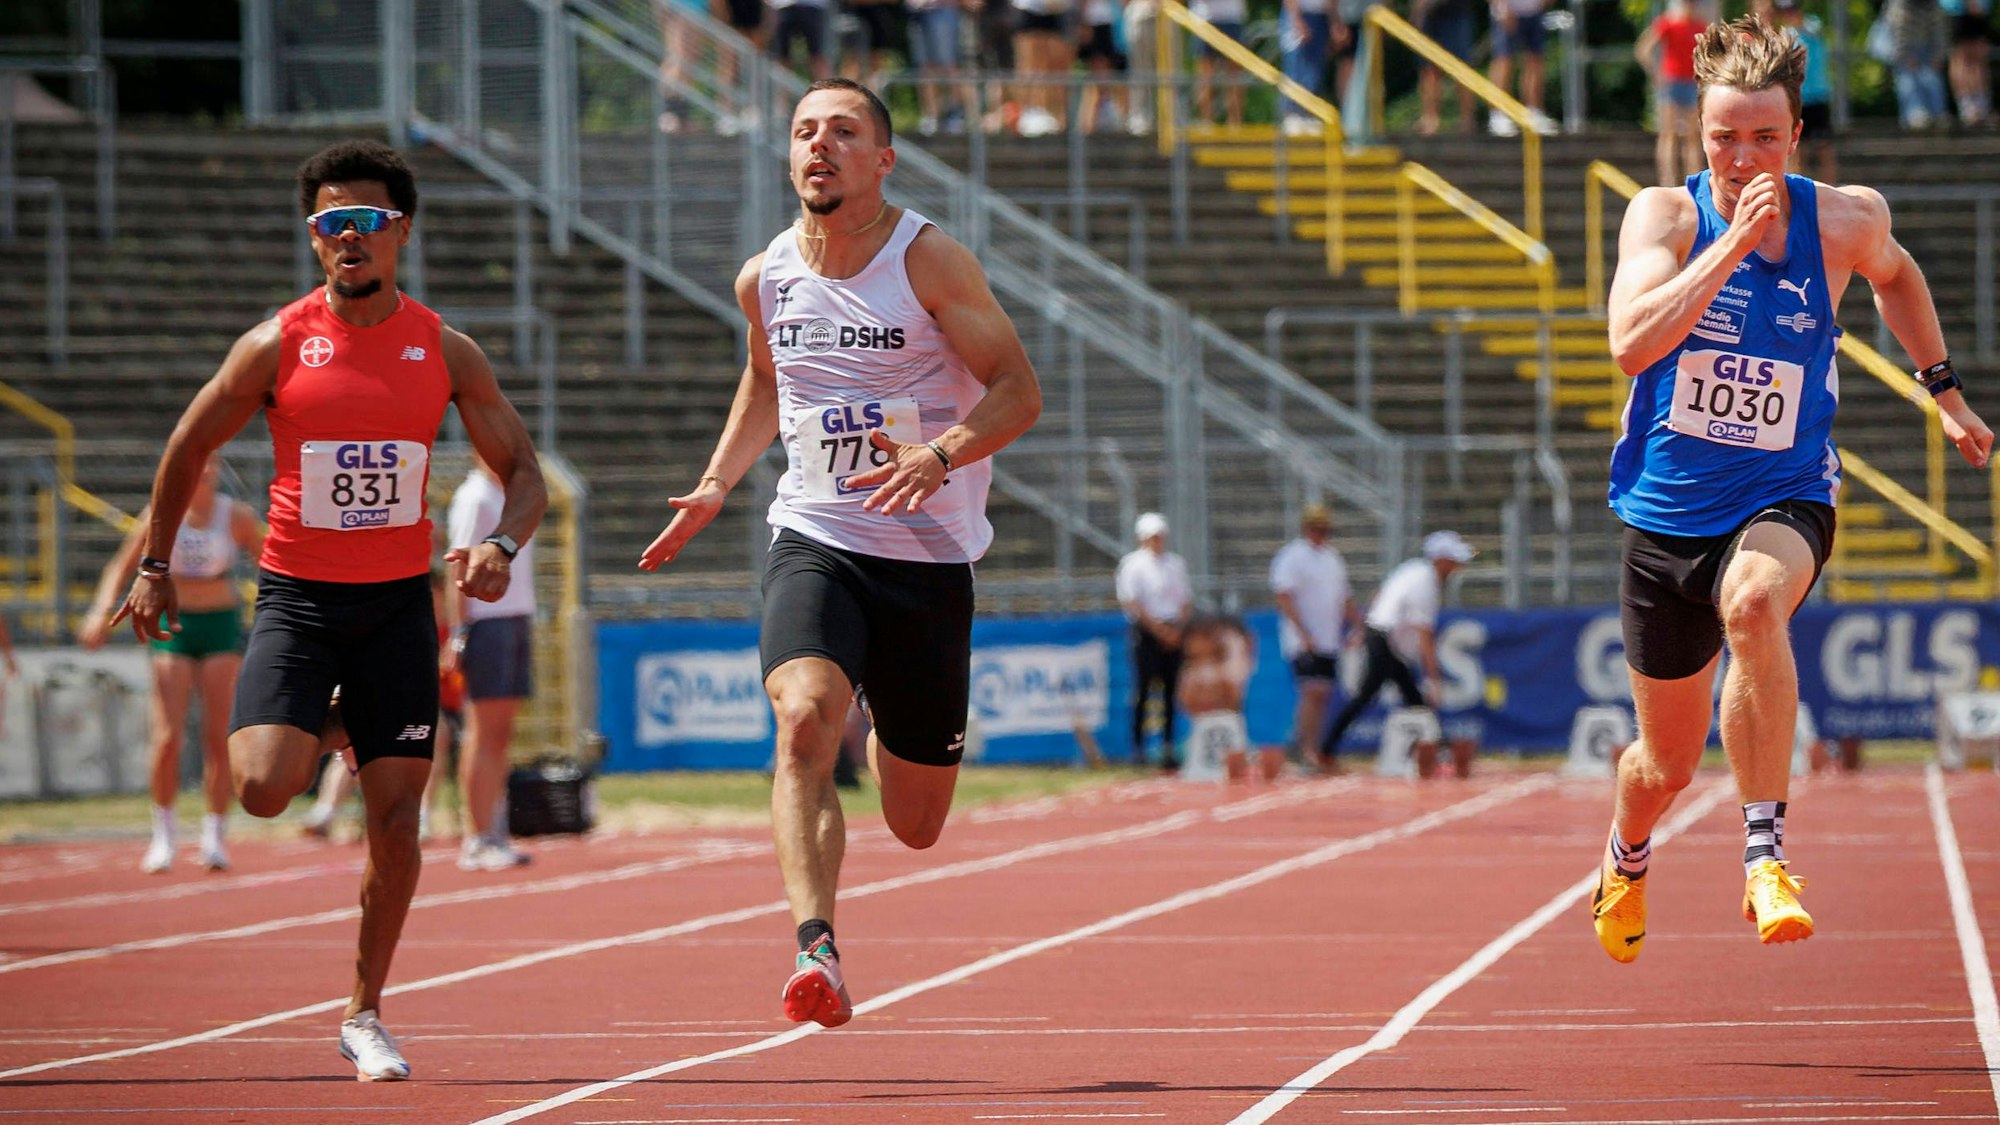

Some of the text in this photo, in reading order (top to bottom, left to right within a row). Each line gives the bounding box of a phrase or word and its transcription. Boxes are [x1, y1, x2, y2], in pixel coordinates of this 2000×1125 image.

[1703, 308, 1732, 322] Radio
[778, 324, 802, 347] LT
[840, 325, 906, 350] DSHS
[1687, 377, 1785, 426] 1030
[1727, 425, 1757, 438] PLAN
[820, 431, 891, 473] 778
[331, 473, 401, 507] 831
[361, 511, 388, 521] PLAN
